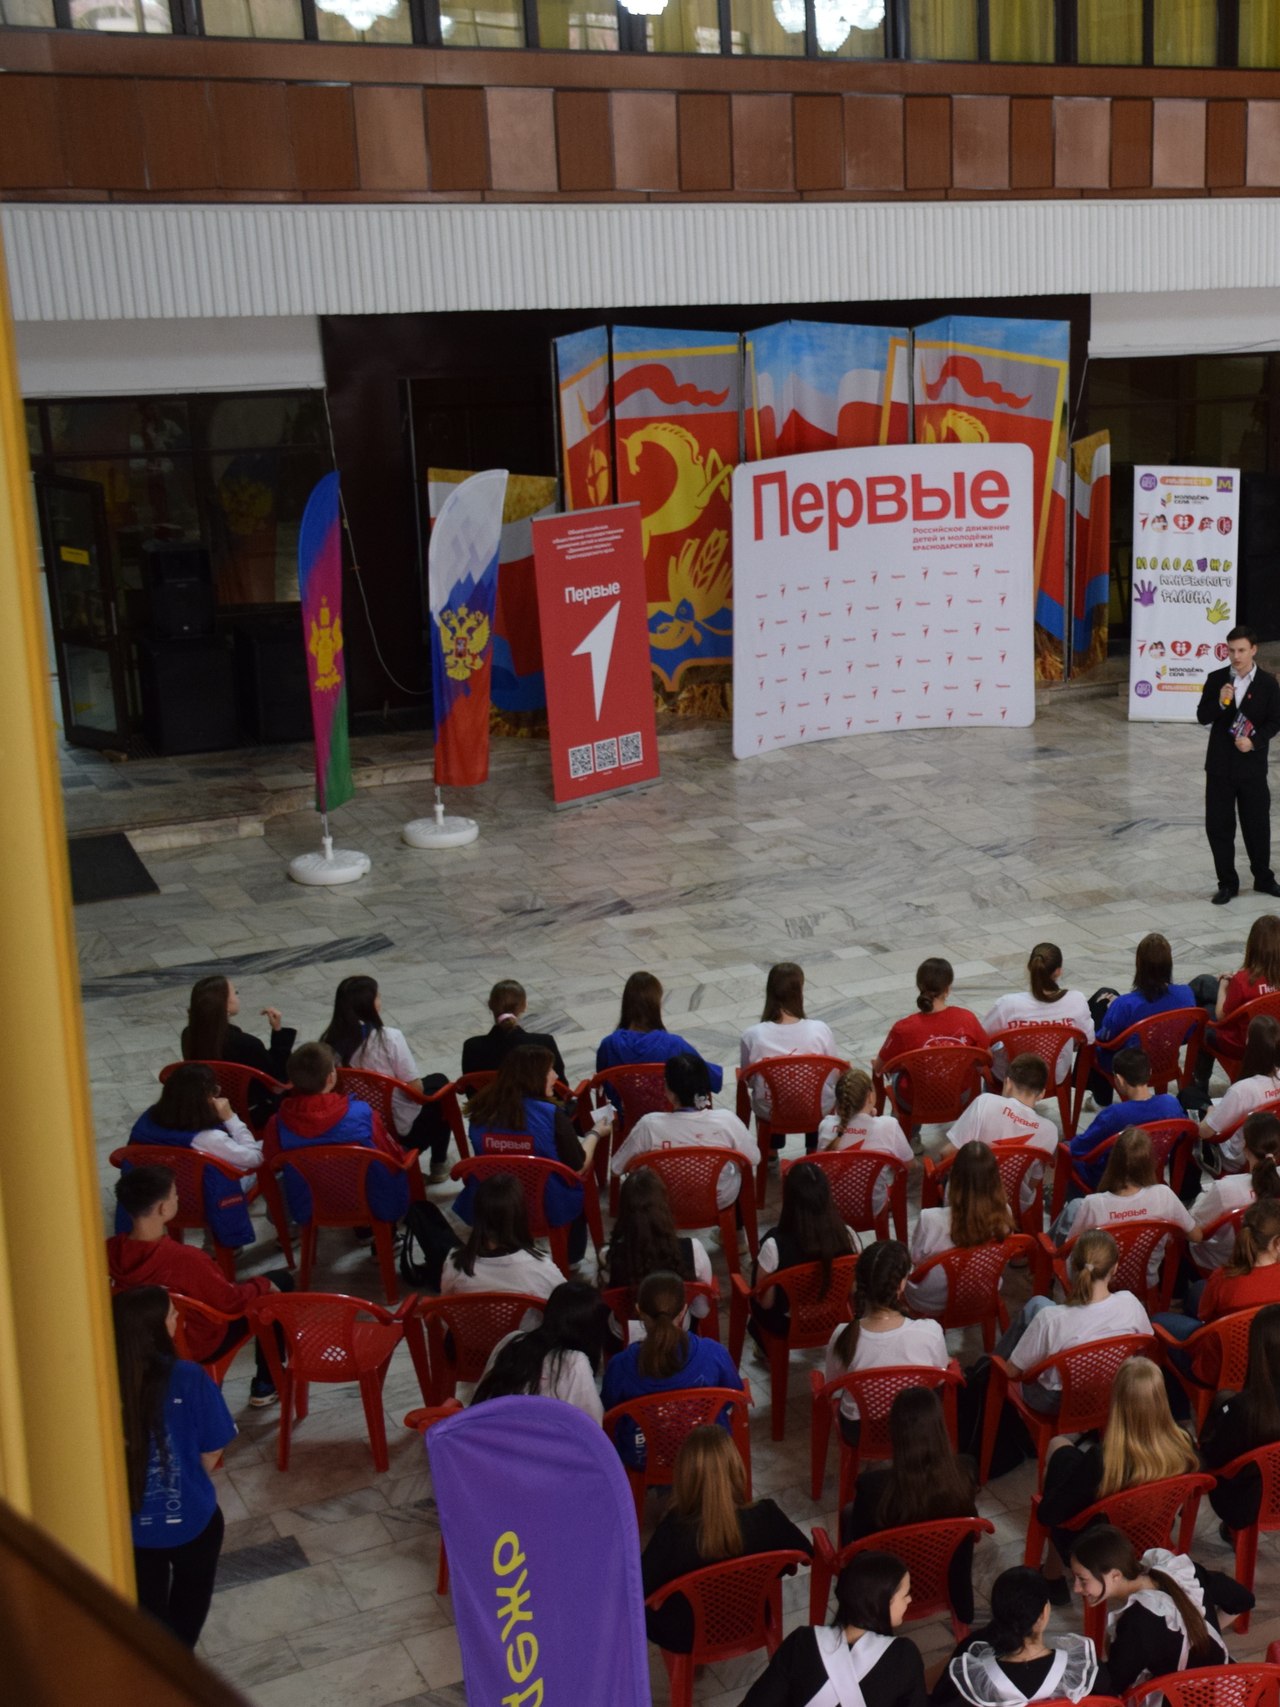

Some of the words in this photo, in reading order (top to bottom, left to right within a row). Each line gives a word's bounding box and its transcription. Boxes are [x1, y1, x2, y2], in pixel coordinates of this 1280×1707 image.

[753, 470, 1010, 551] Первые
[912, 526, 963, 534] Российское
[913, 535, 938, 543] детей
[912, 542, 974, 551] КРАСНОДАРСКИЙ
[565, 582, 620, 605] Первые
[1003, 1106, 1039, 1129] Первые
[832, 1125, 867, 1135] Пвые
[486, 1136, 531, 1152] Первые
[1109, 1208, 1147, 1220] Первые
